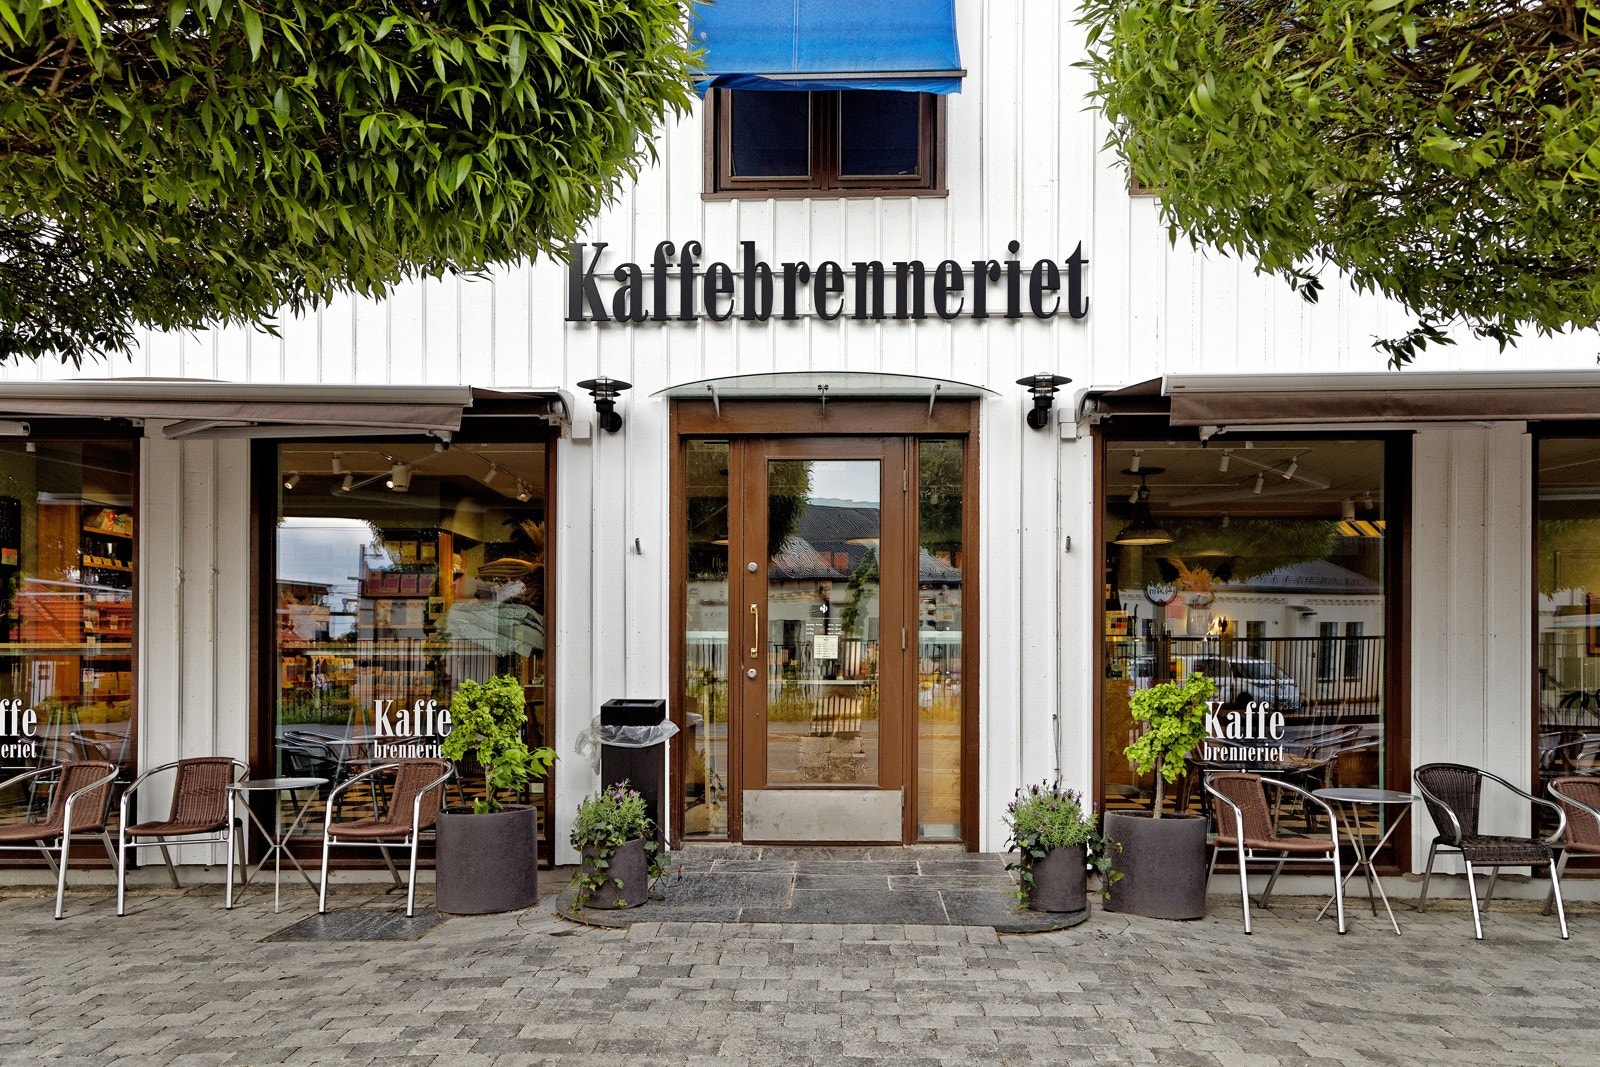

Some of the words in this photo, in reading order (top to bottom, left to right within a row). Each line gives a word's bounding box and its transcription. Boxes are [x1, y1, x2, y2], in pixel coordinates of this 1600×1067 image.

[565, 240, 1089, 322] Kaffebrenneriet
[374, 700, 452, 737] Kaffe
[1205, 701, 1285, 739] Kaffe
[374, 740, 451, 758] brennerie
[1203, 742, 1284, 761] brenneriet
